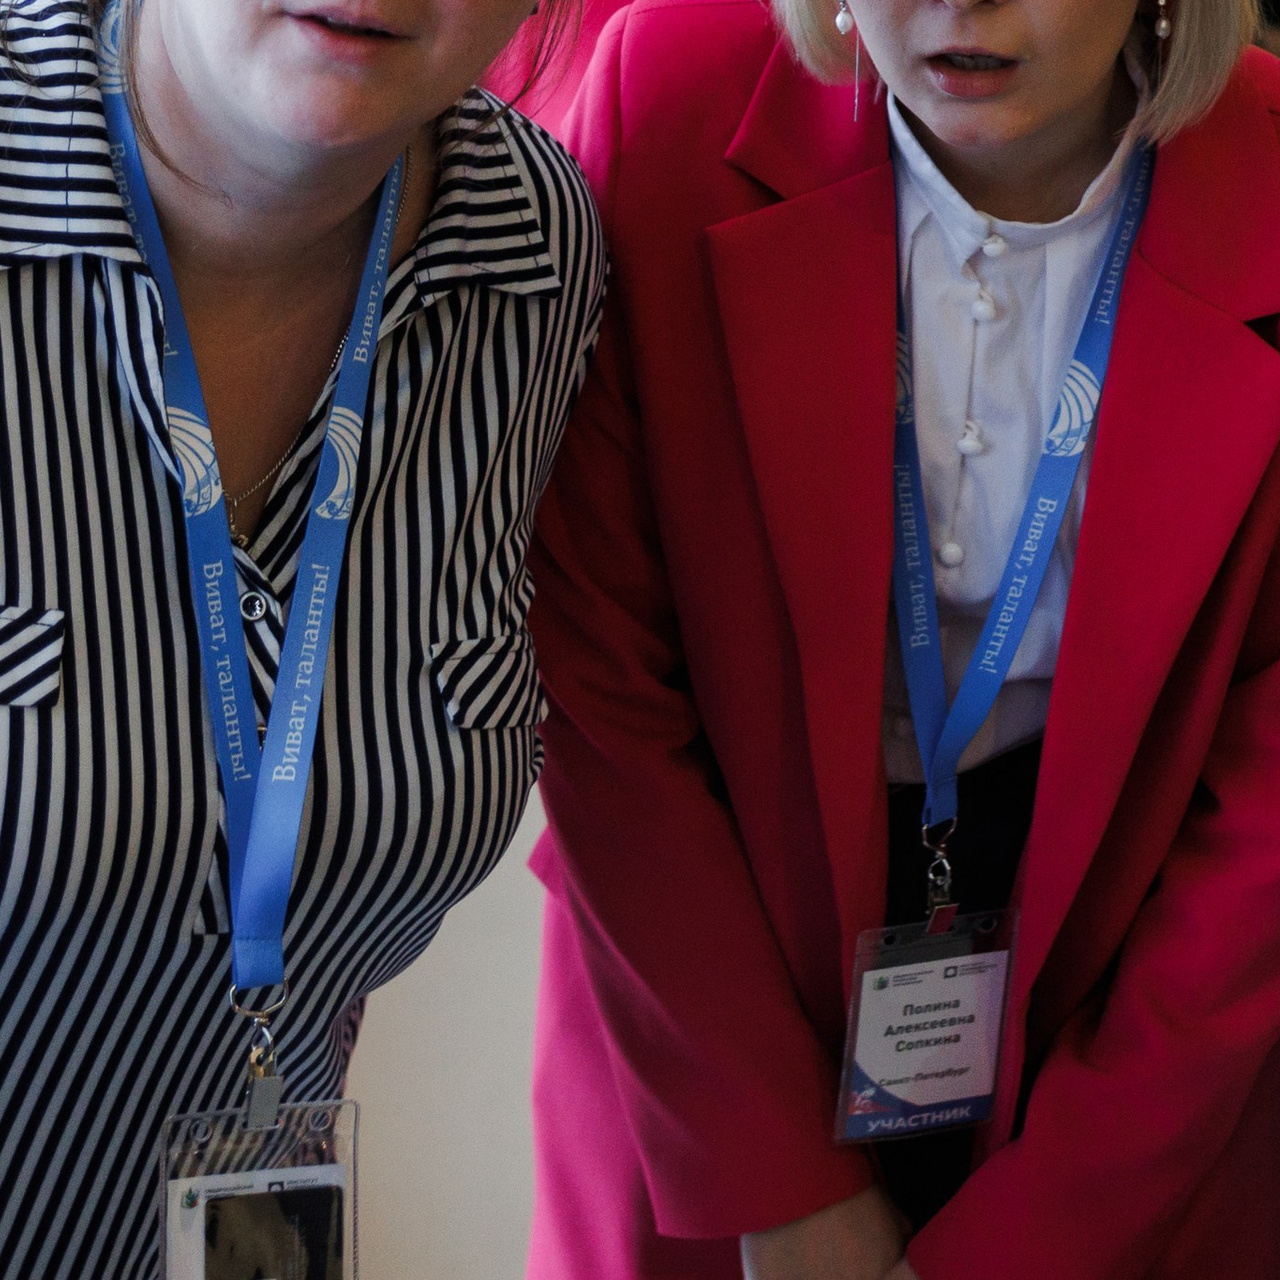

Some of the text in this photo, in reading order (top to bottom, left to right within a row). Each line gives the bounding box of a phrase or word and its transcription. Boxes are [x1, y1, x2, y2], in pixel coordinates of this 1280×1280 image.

[110, 141, 137, 223] Виват
[353, 163, 399, 364] Виват, таланты
[1094, 218, 1135, 325] таланты!
[894, 463, 931, 649] Виват, таланты!
[979, 496, 1058, 674] Виват, таланты!
[202, 559, 251, 781] Виват, таланты!
[272, 562, 330, 783] Виват, таланты!
[884, 1014, 976, 1037] Алексеевна
[895, 1034, 961, 1052] Сопкина
[903, 999, 960, 1017] Полина
[867, 1106, 972, 1132] УЧАСТНИК
